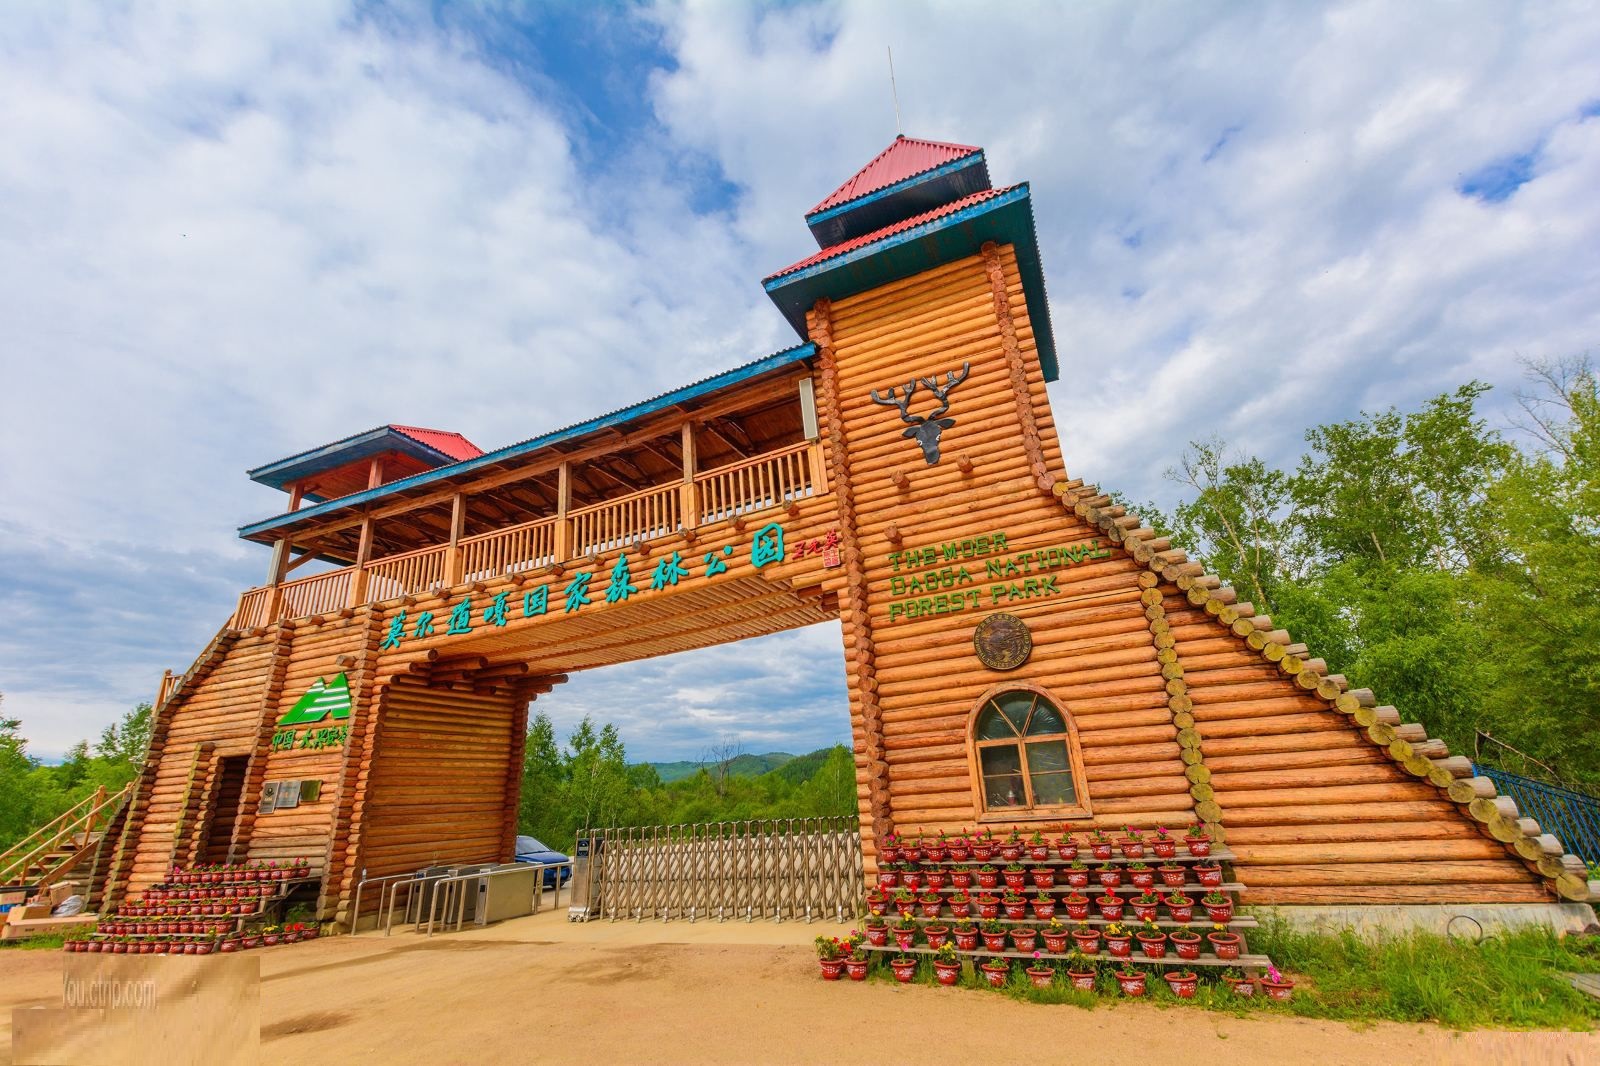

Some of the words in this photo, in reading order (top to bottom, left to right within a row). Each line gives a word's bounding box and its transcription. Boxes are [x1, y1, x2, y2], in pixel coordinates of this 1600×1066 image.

[888, 546, 939, 571] THE
[941, 532, 1009, 561] MOER
[890, 566, 973, 596] DAOGA
[985, 540, 1111, 578] NATIONAL
[380, 522, 785, 650] 莫尔道嘎国家森林公园
[889, 588, 982, 622] FOREST
[991, 575, 1061, 603] PARK
